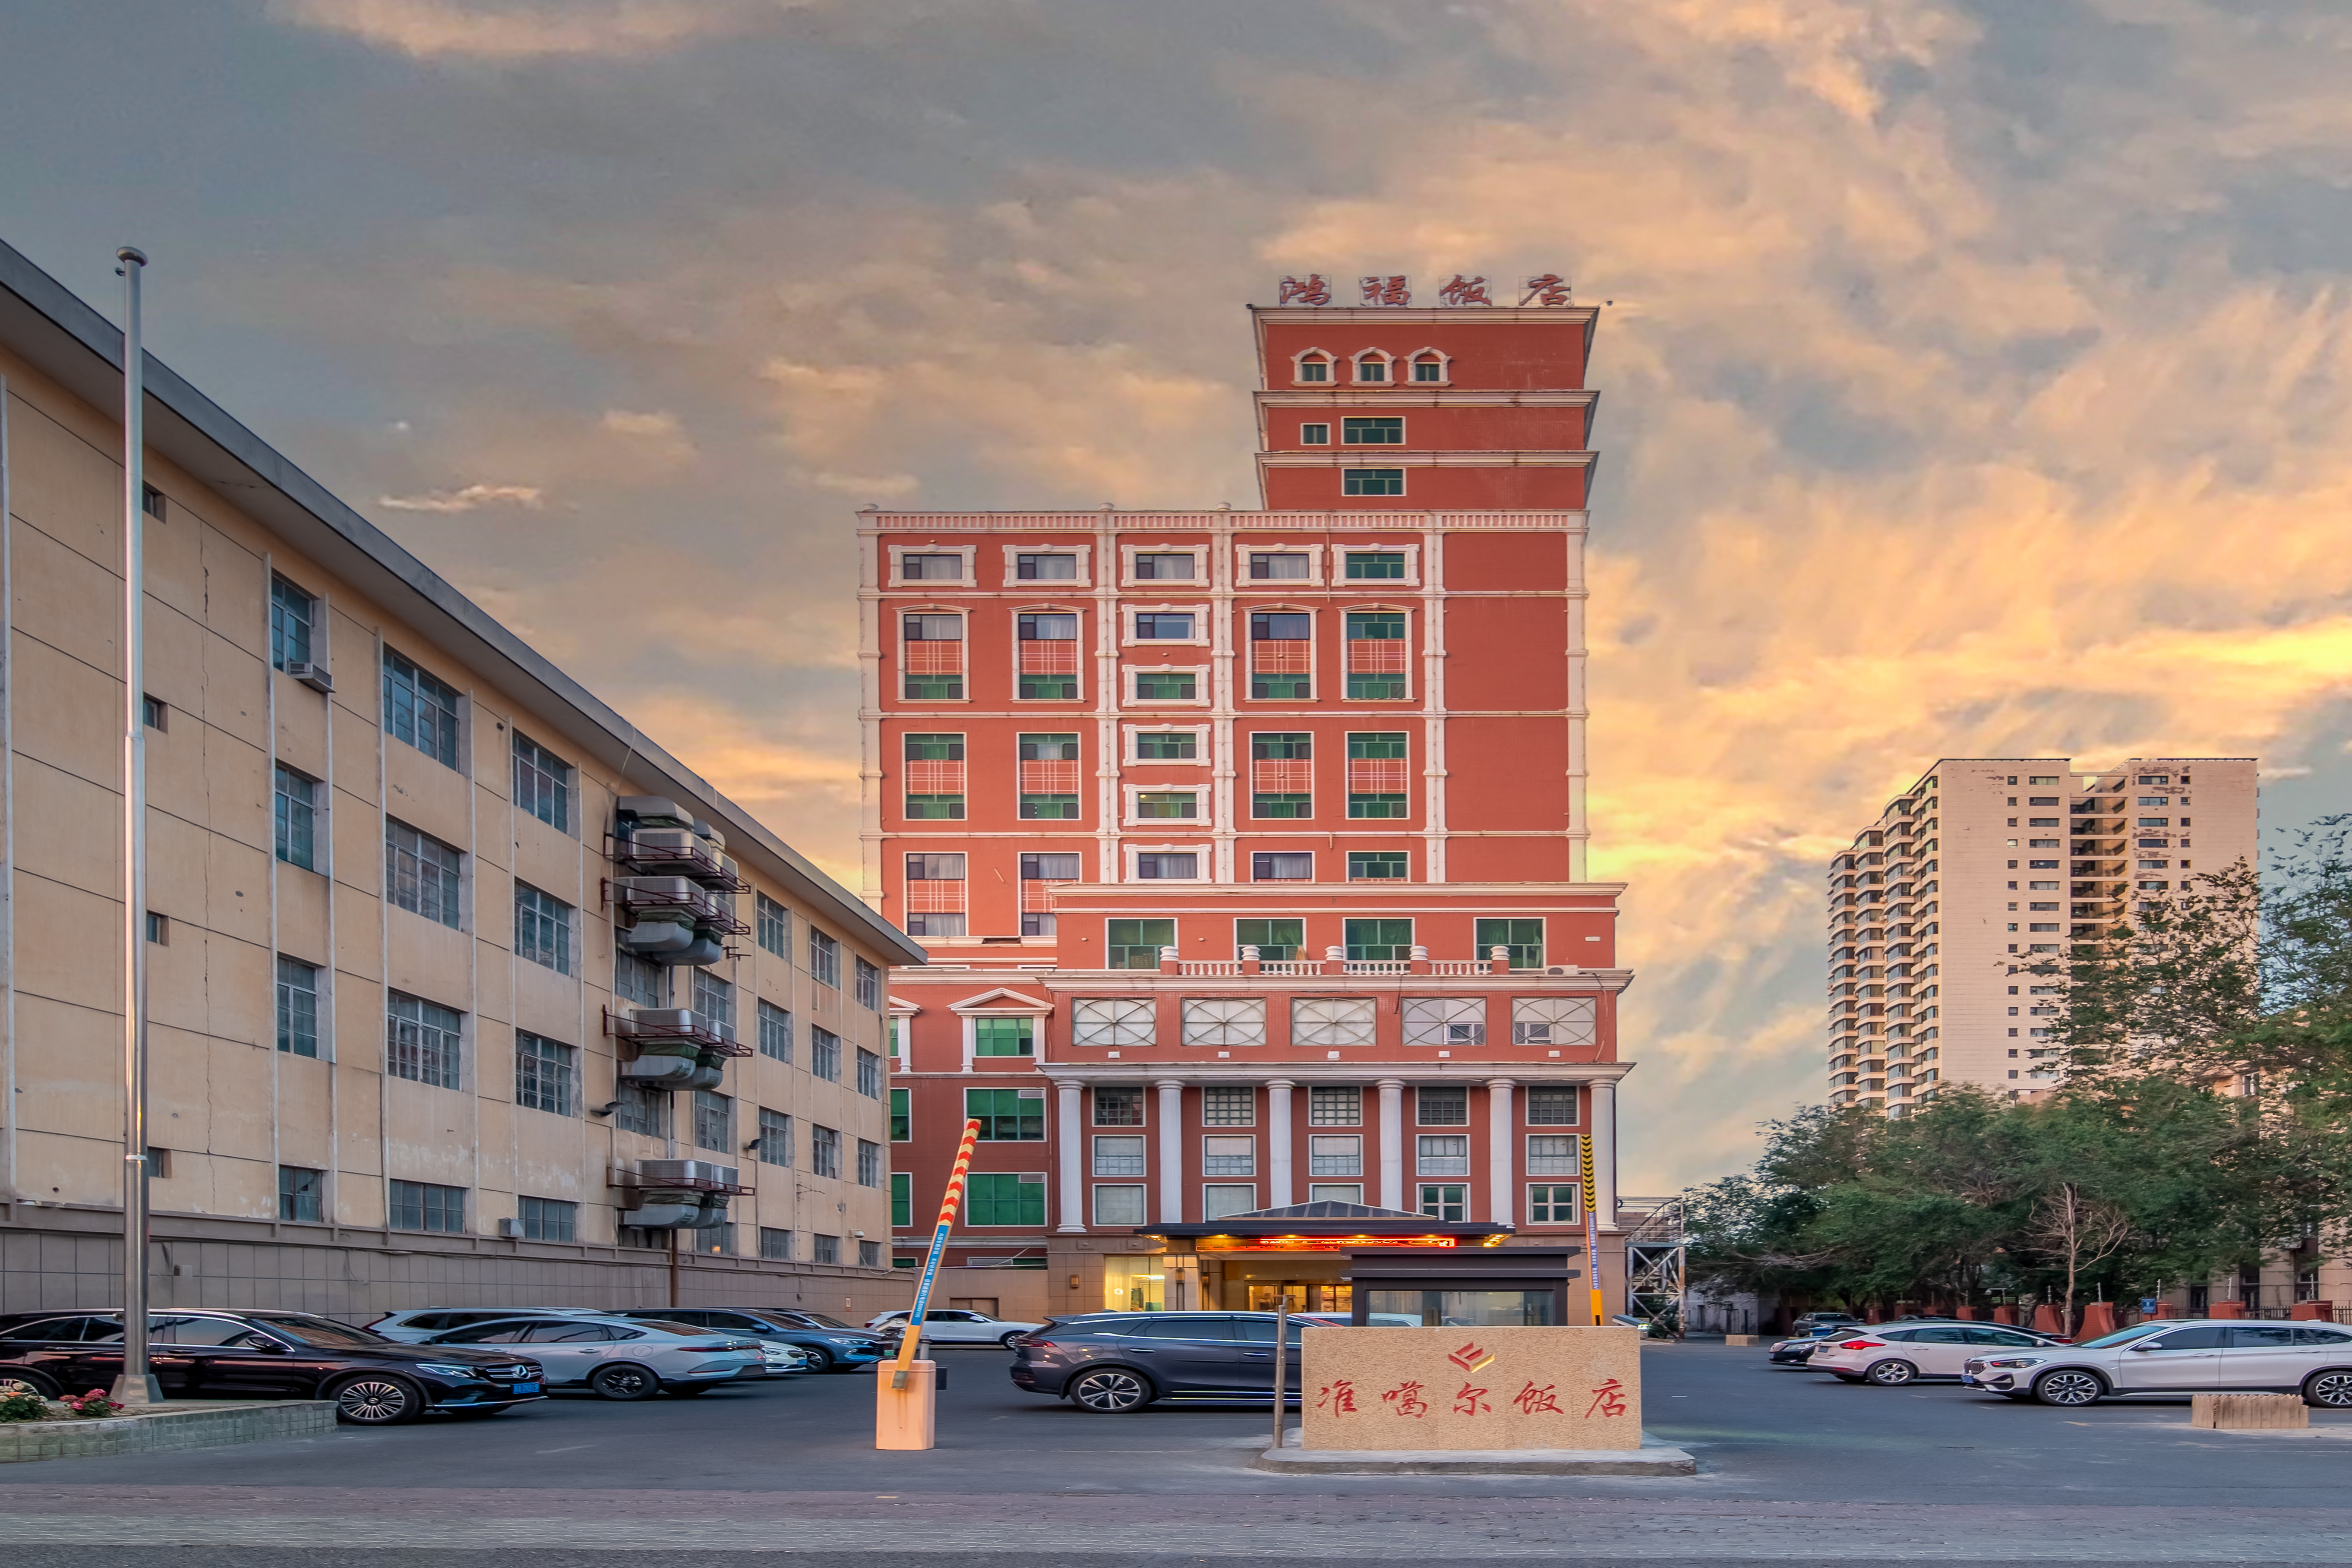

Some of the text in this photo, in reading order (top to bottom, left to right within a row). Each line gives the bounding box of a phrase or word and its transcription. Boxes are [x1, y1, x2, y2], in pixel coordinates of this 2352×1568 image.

[1280, 274, 1571, 306] 鸿福饭店
[1316, 1378, 1627, 1419] 准噶尔饭店
